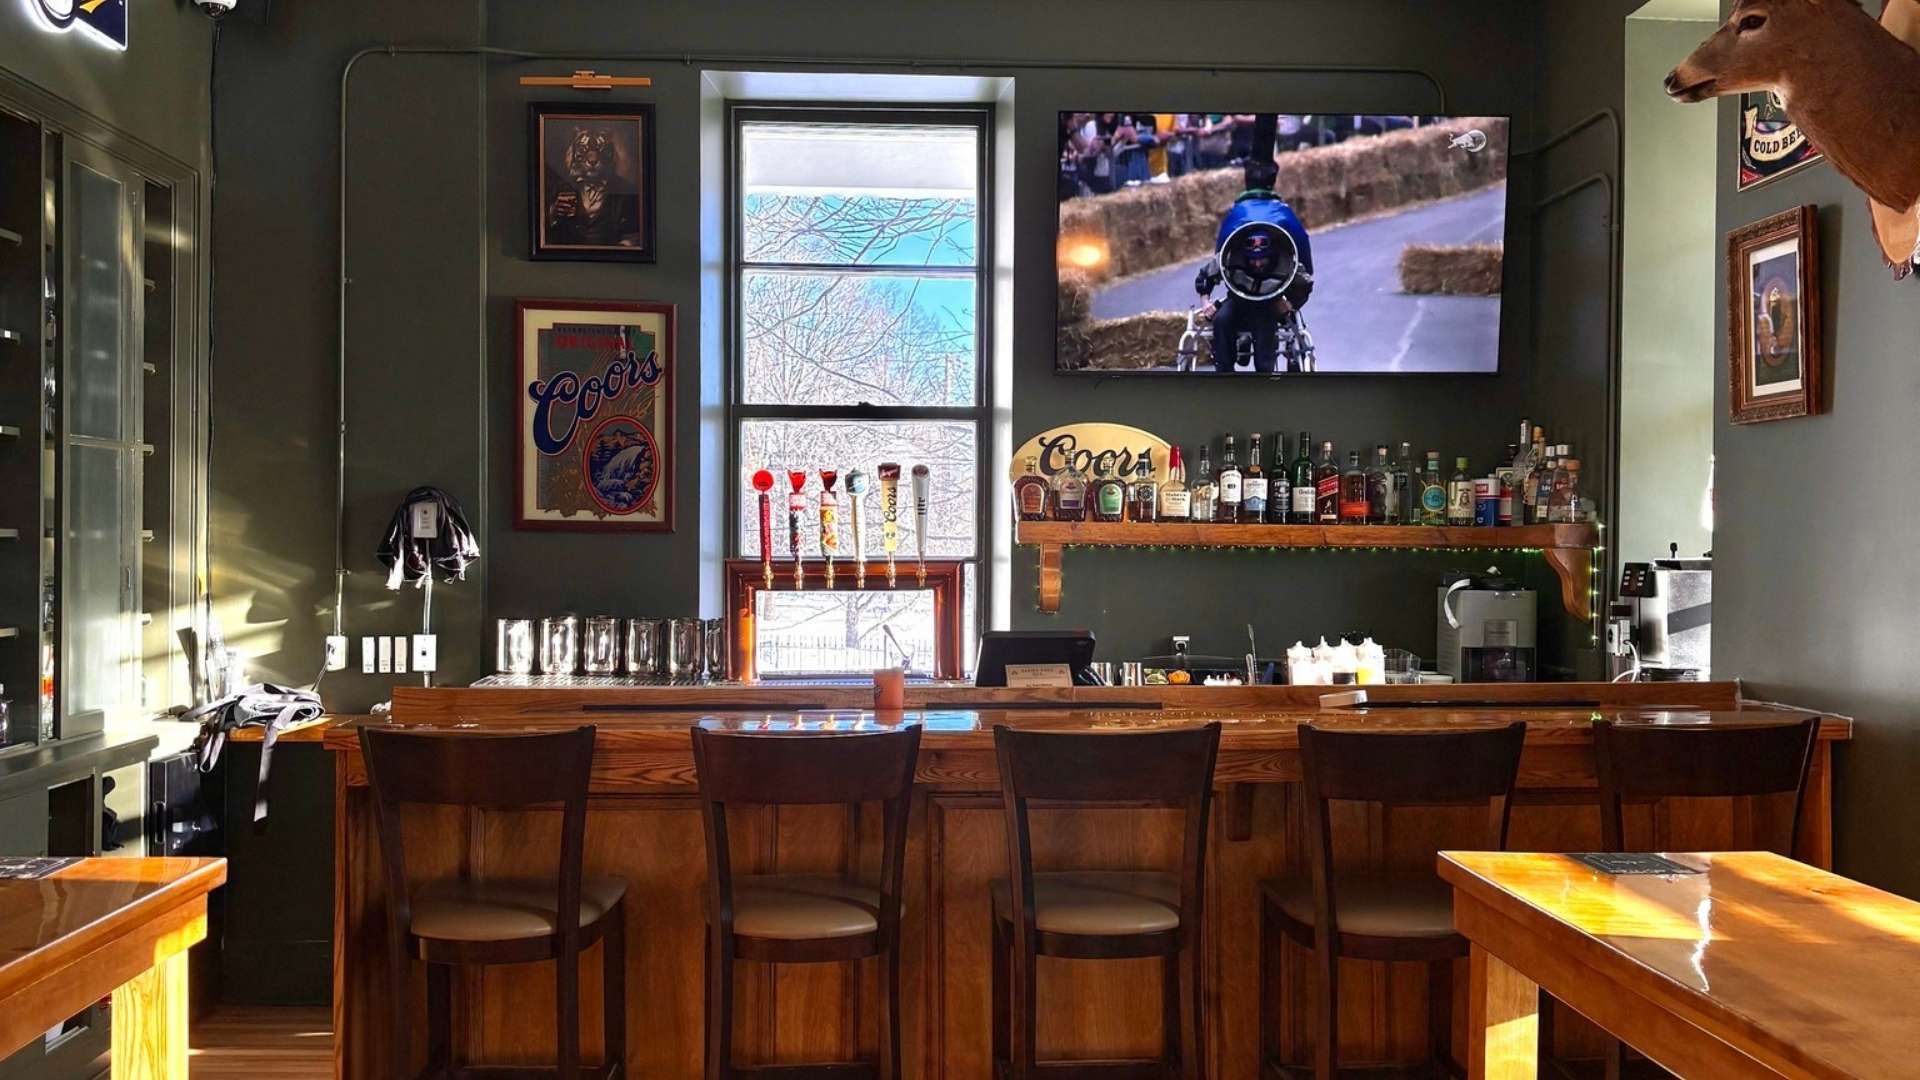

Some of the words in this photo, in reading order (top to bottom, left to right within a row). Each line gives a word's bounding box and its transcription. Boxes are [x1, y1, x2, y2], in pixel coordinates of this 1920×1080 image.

[1754, 140, 1780, 154] COLD
[528, 351, 663, 455] Coors
[1038, 434, 1156, 476] Coors
[884, 487, 897, 523] Coors
